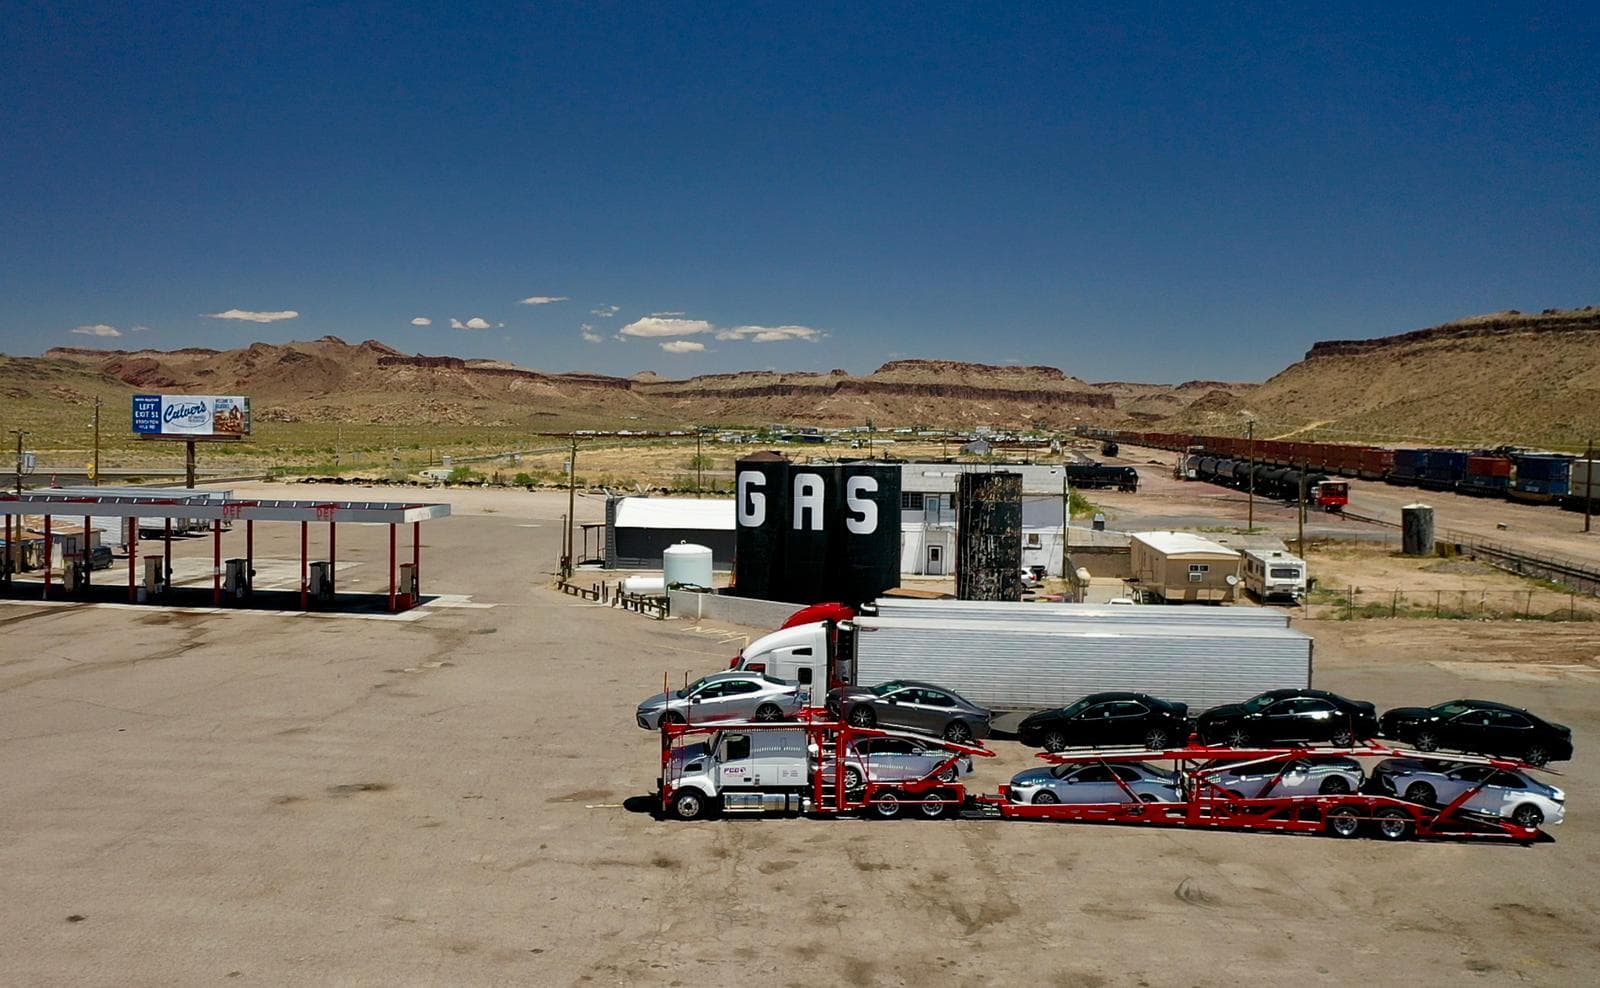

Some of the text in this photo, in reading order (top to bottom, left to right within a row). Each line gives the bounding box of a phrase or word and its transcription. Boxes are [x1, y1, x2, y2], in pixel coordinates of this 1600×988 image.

[139, 403, 155, 411] LEFT
[163, 400, 208, 423] Culver's
[738, 470, 879, 535] GAS
